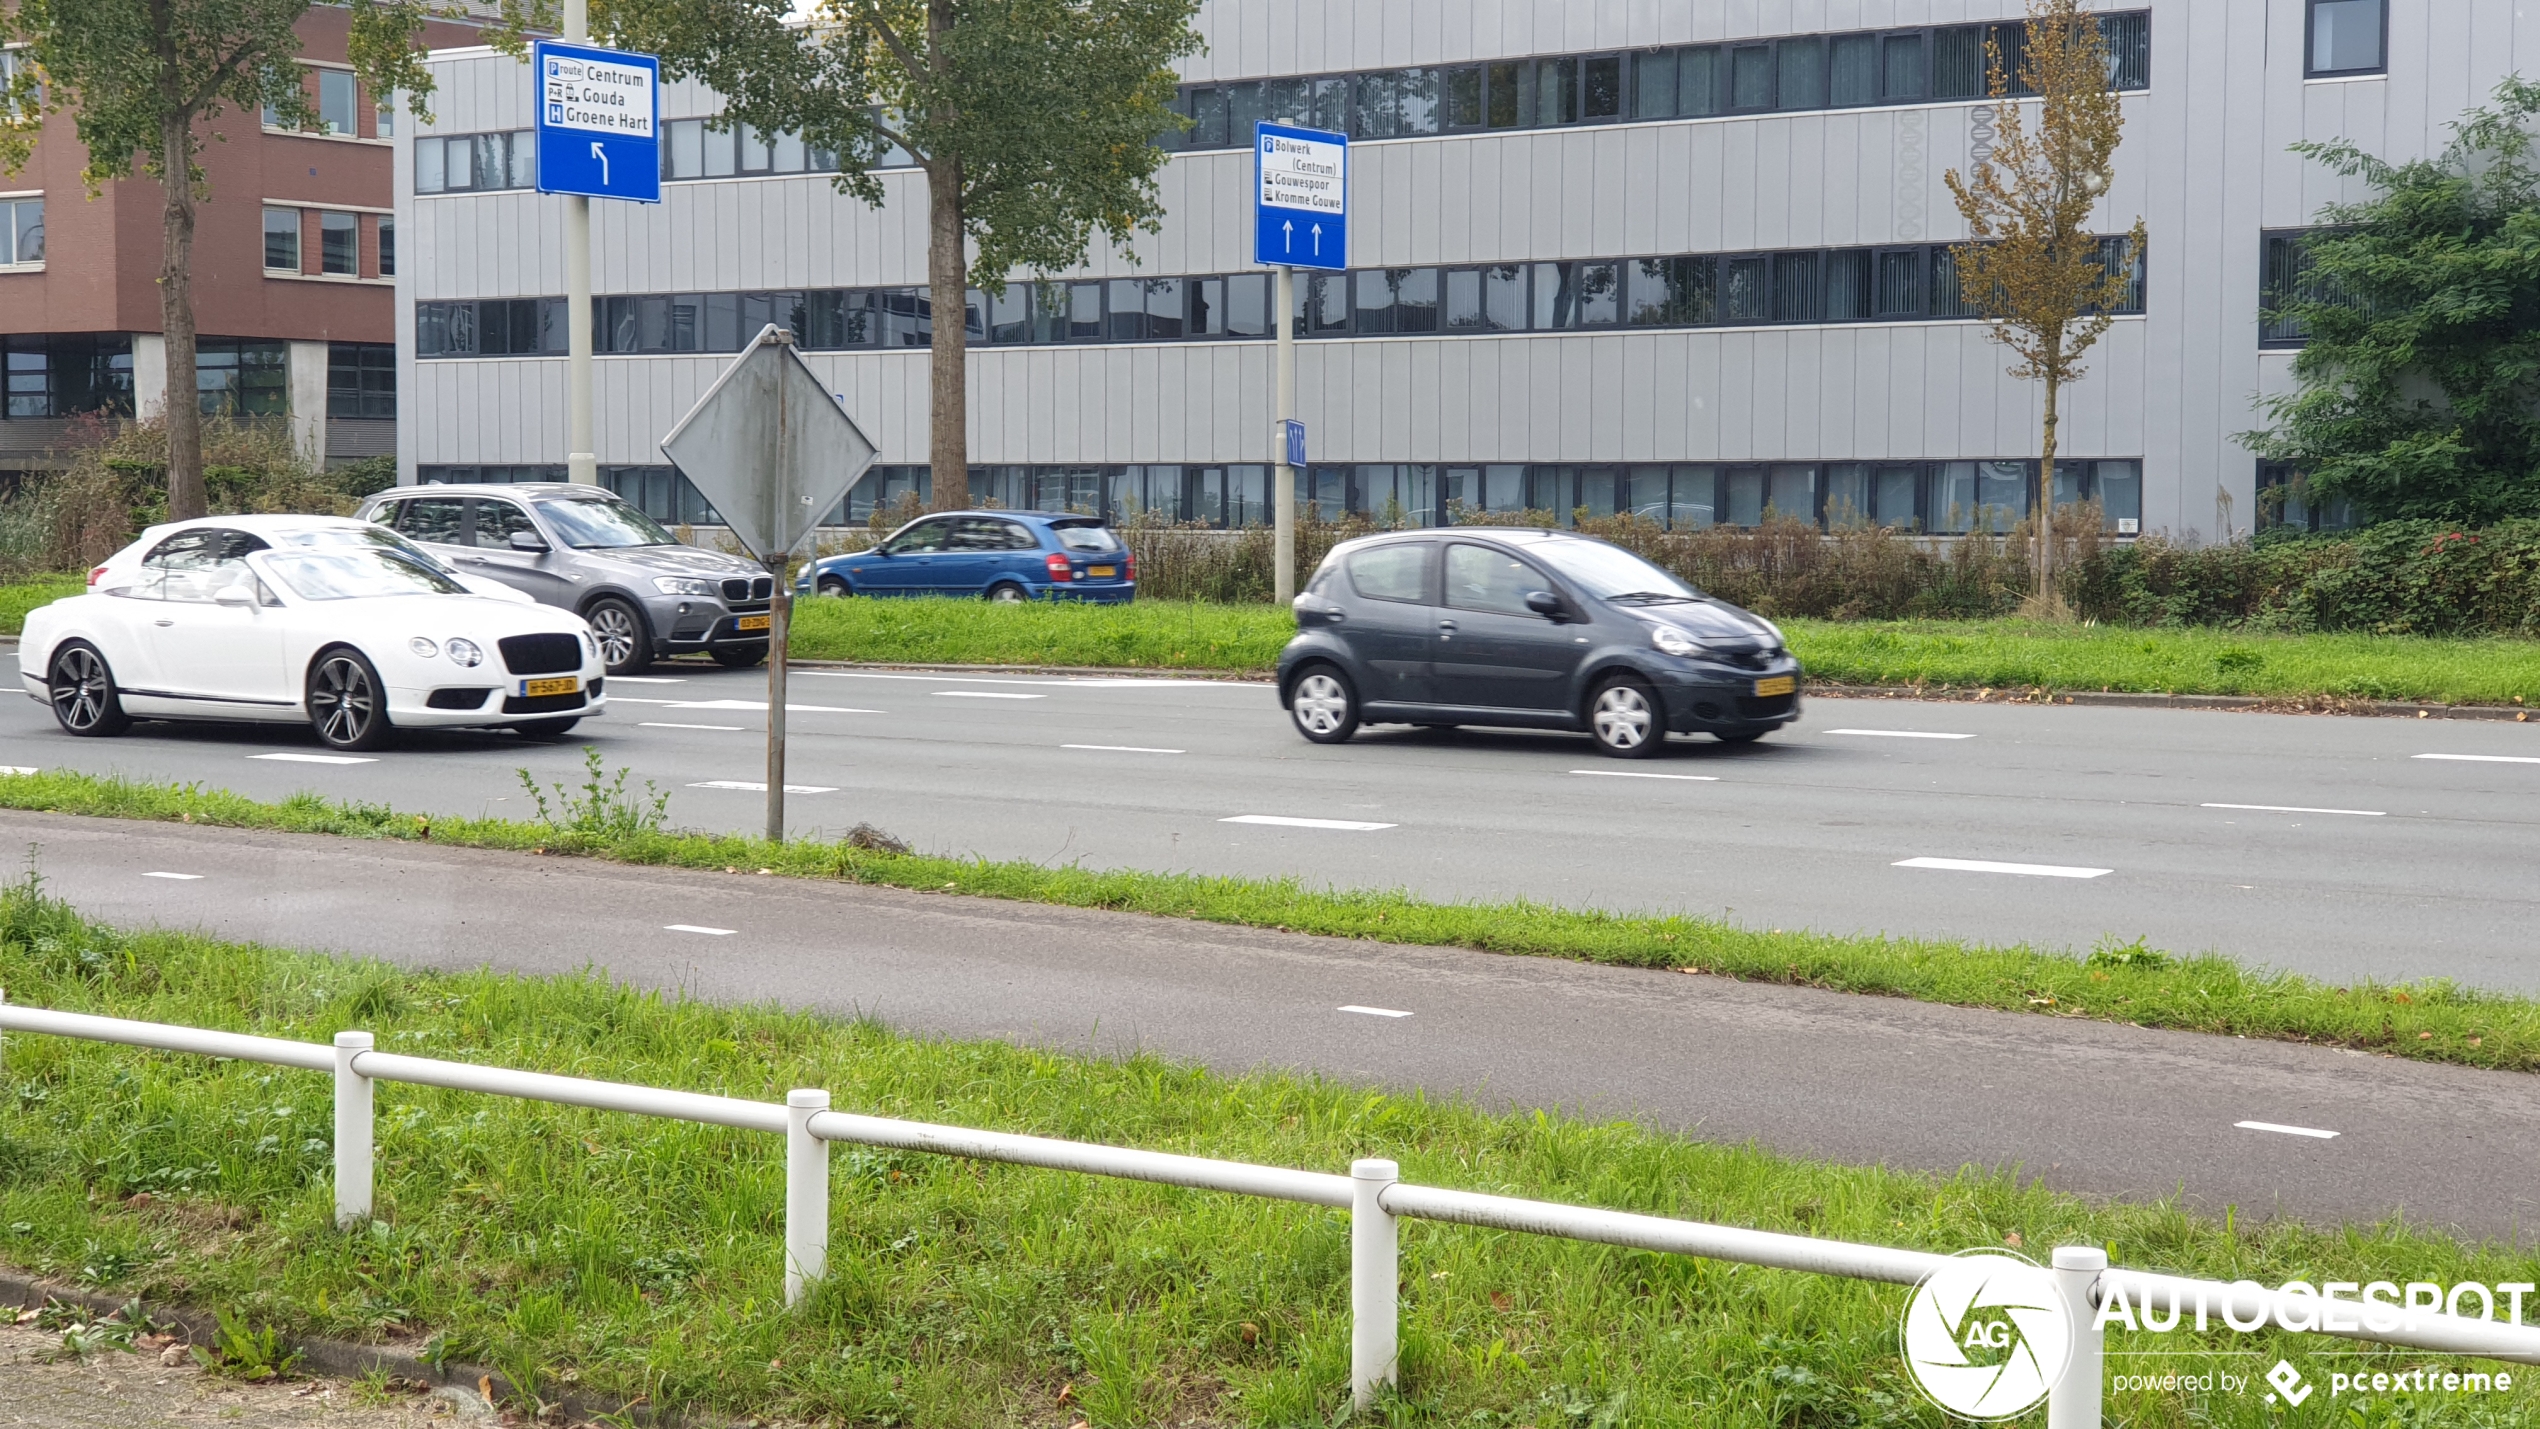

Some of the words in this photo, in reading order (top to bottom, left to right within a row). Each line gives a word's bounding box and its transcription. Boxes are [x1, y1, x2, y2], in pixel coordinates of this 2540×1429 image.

[550, 63, 557, 74] P
[559, 64, 582, 76] route
[587, 66, 643, 87] Centrum
[548, 87, 563, 98] P+R
[583, 88, 625, 106] Gouda
[550, 105, 561, 122] H
[566, 107, 615, 126] Groene
[619, 113, 648, 130] Hart
[1275, 139, 1311, 155] Bolwerk
[1292, 158, 1337, 176] (Centrum)
[1275, 173, 1330, 191] Gouwespoor
[1275, 190, 1310, 205] Kromme
[1312, 195, 1341, 209] Gouwe
[528, 679, 576, 694] H-567-JD
